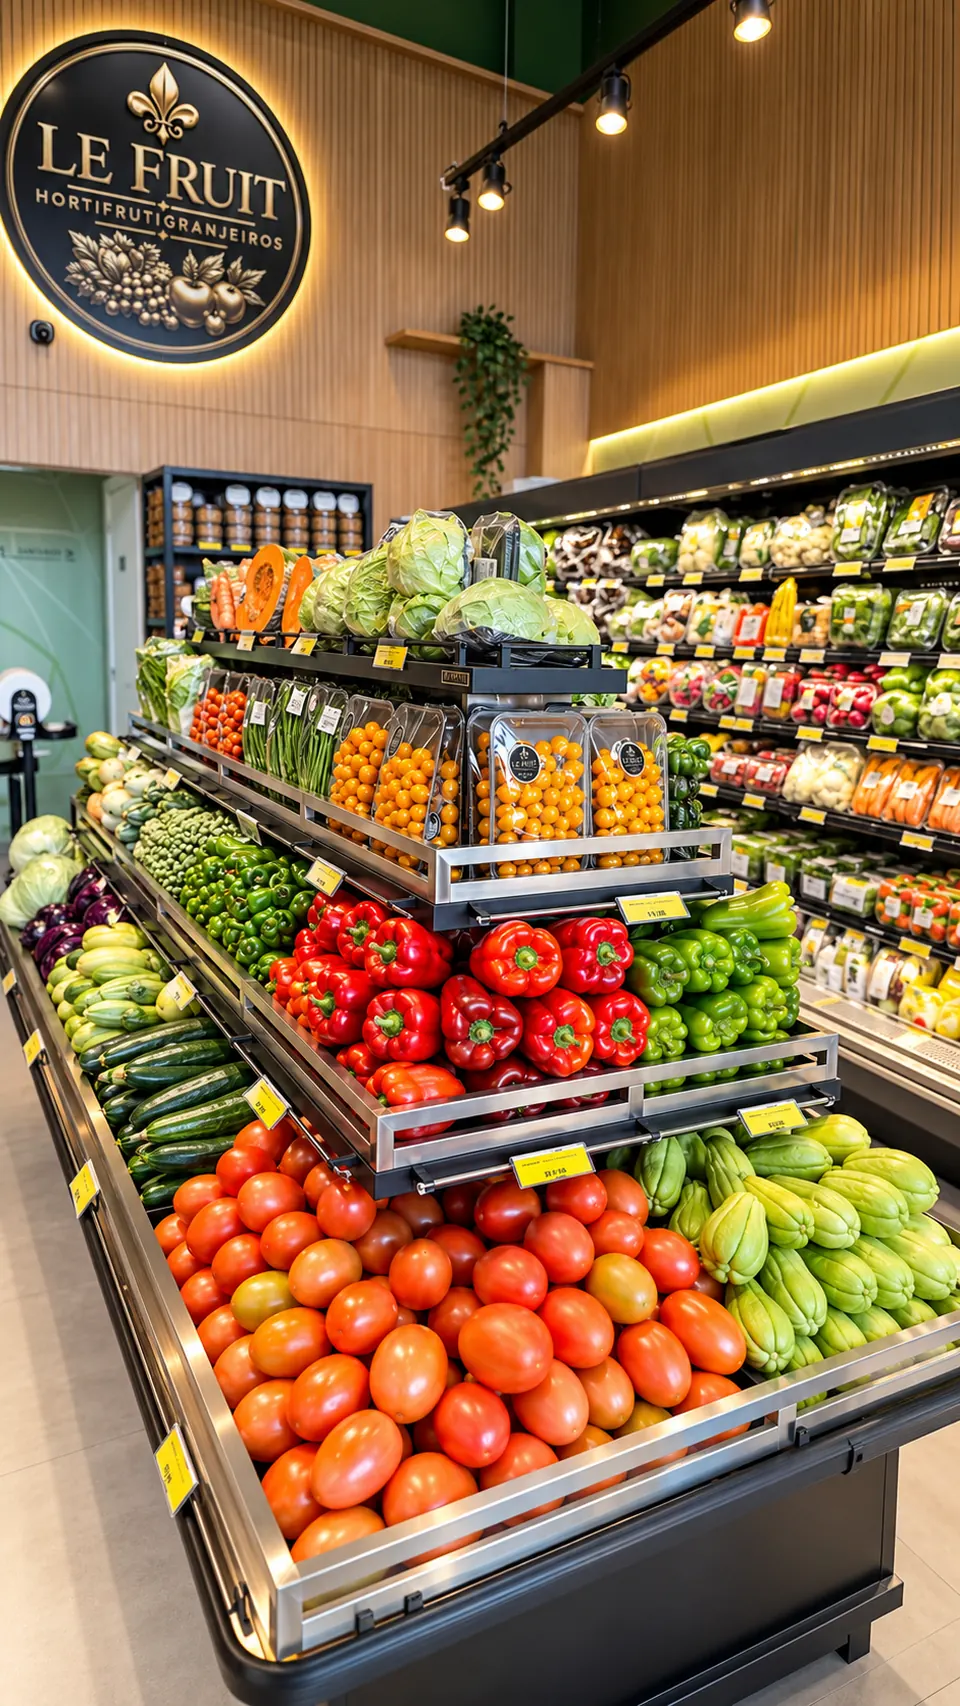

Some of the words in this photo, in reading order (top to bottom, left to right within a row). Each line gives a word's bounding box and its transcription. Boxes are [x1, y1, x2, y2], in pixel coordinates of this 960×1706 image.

[36, 121, 114, 186] LE
[130, 141, 287, 221] FRUIT
[35, 188, 284, 251] HORTIFRUTIGRANJEIROS
